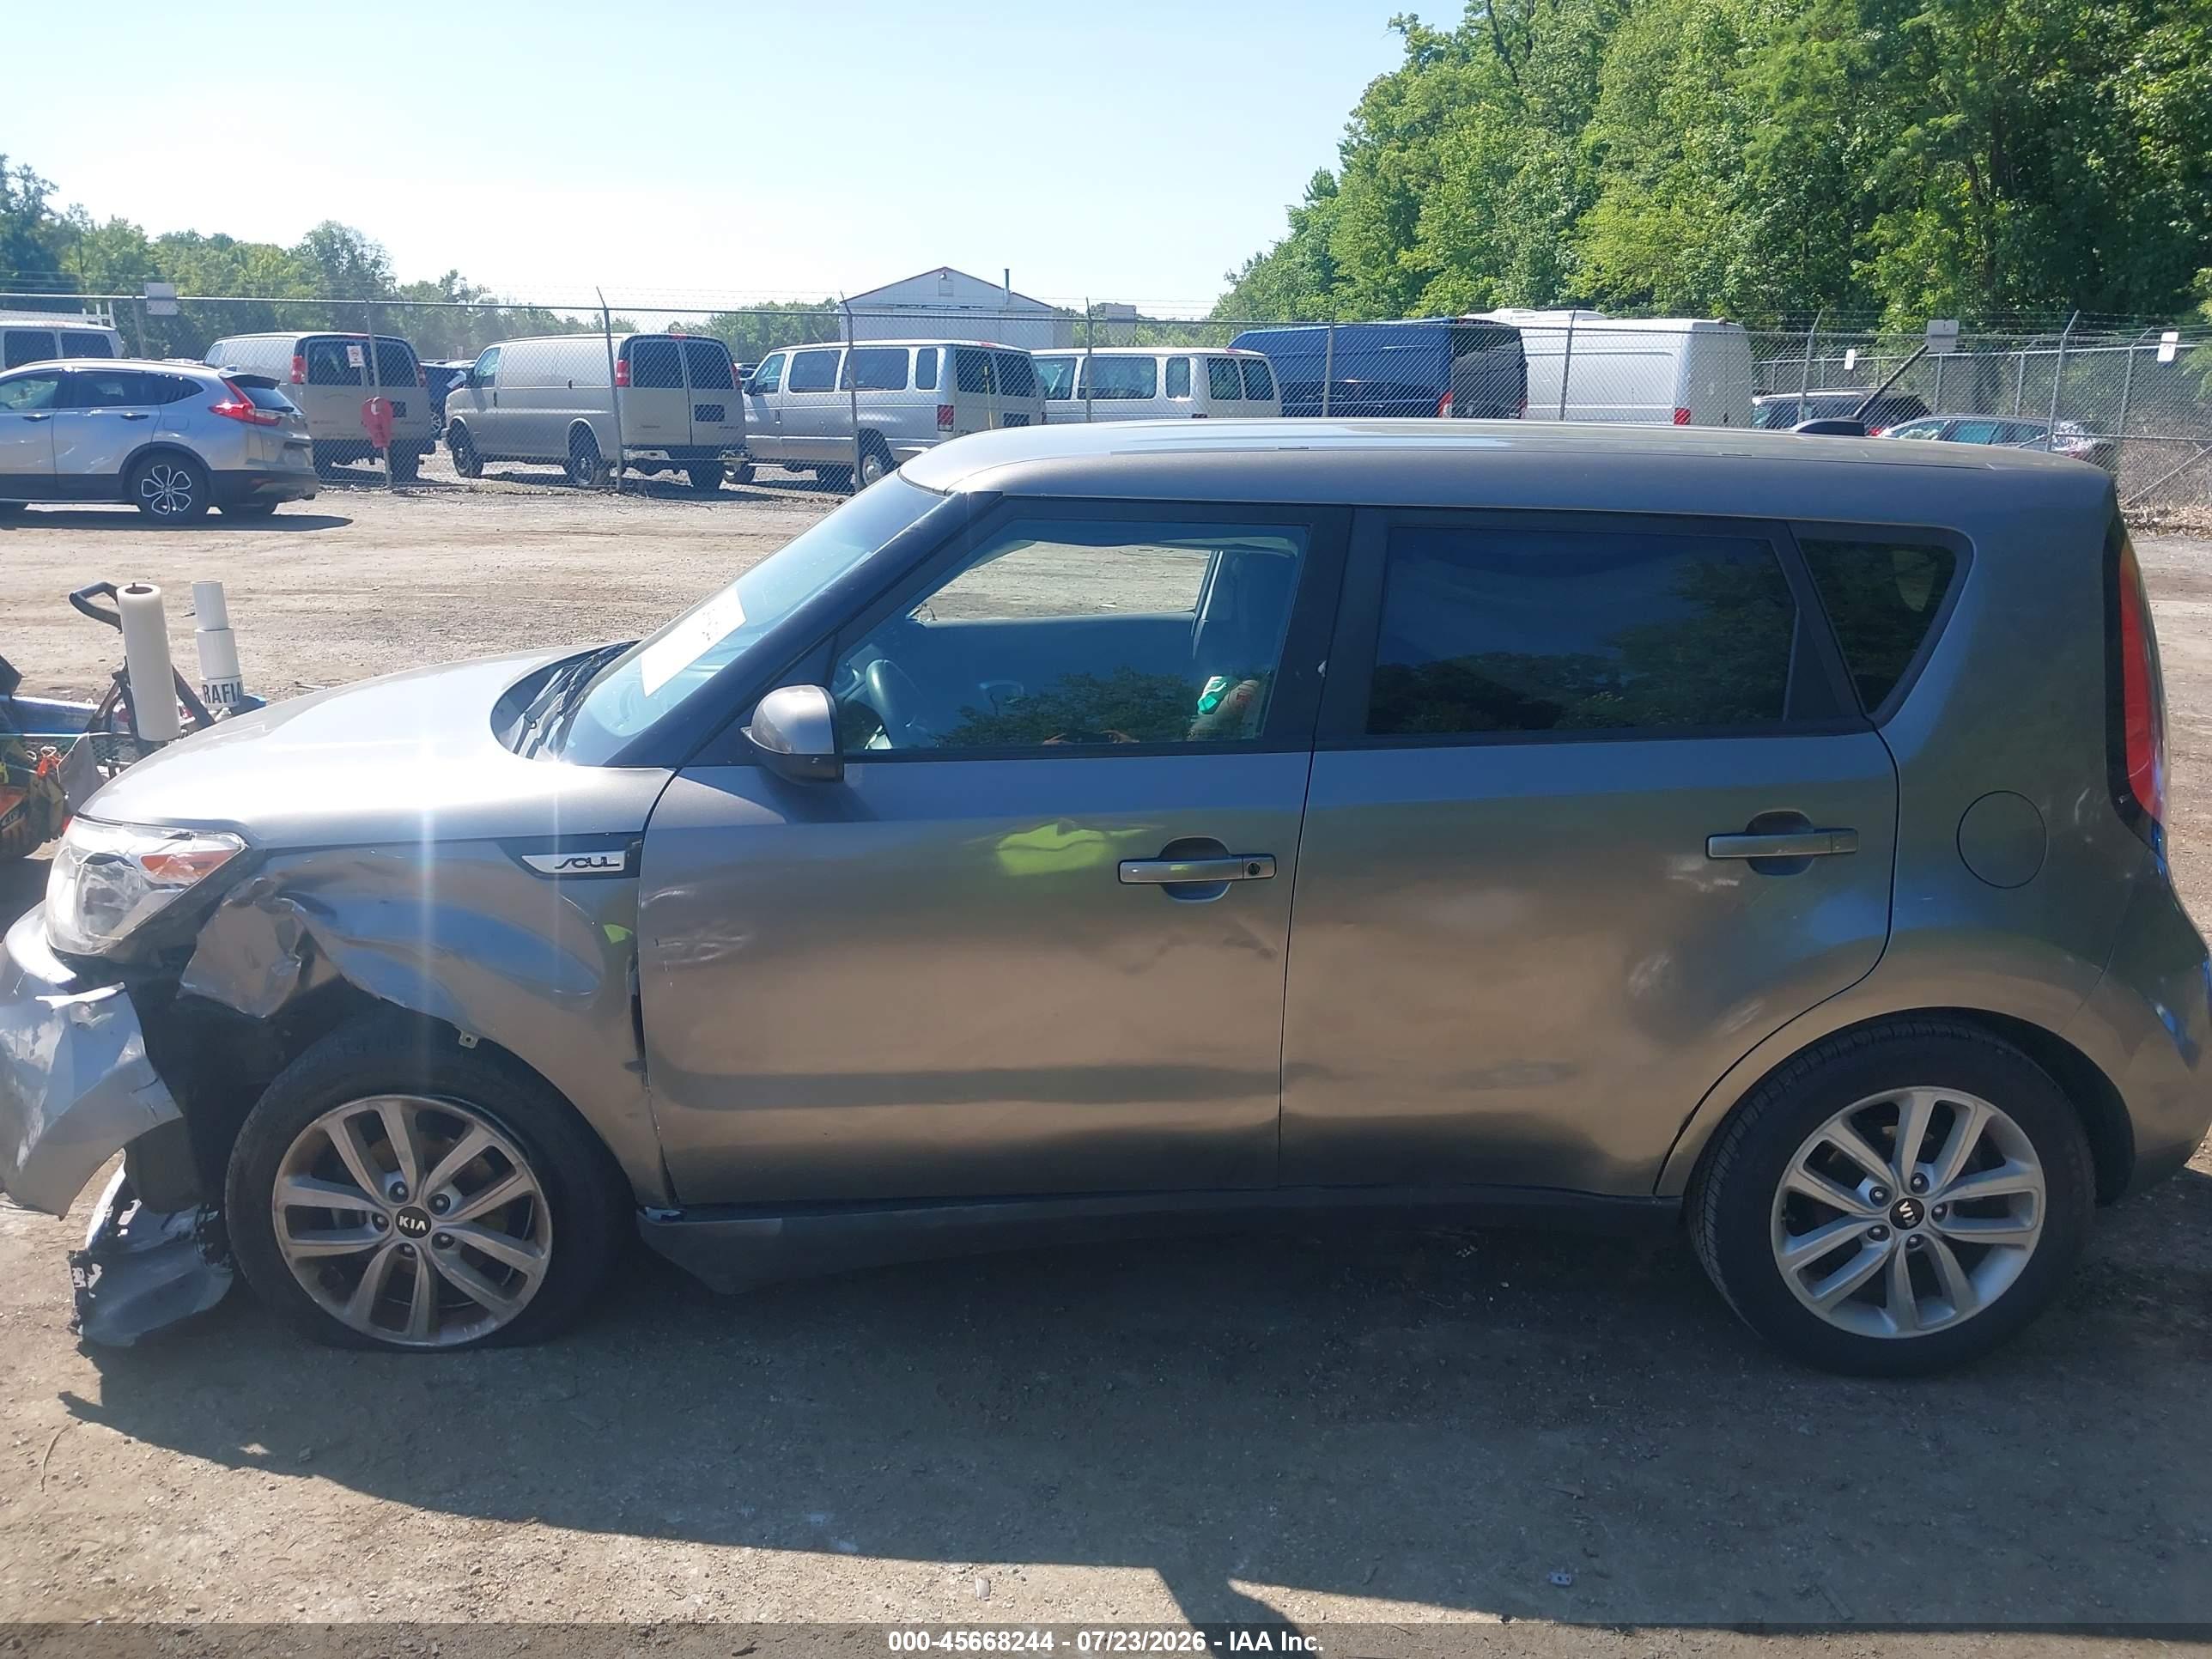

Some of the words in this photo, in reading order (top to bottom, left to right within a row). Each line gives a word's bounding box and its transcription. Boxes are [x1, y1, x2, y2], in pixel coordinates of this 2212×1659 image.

[554, 856, 620, 870] SOUL
[1899, 1200, 1917, 1227] KIA
[398, 1215, 427, 1231] KIA
